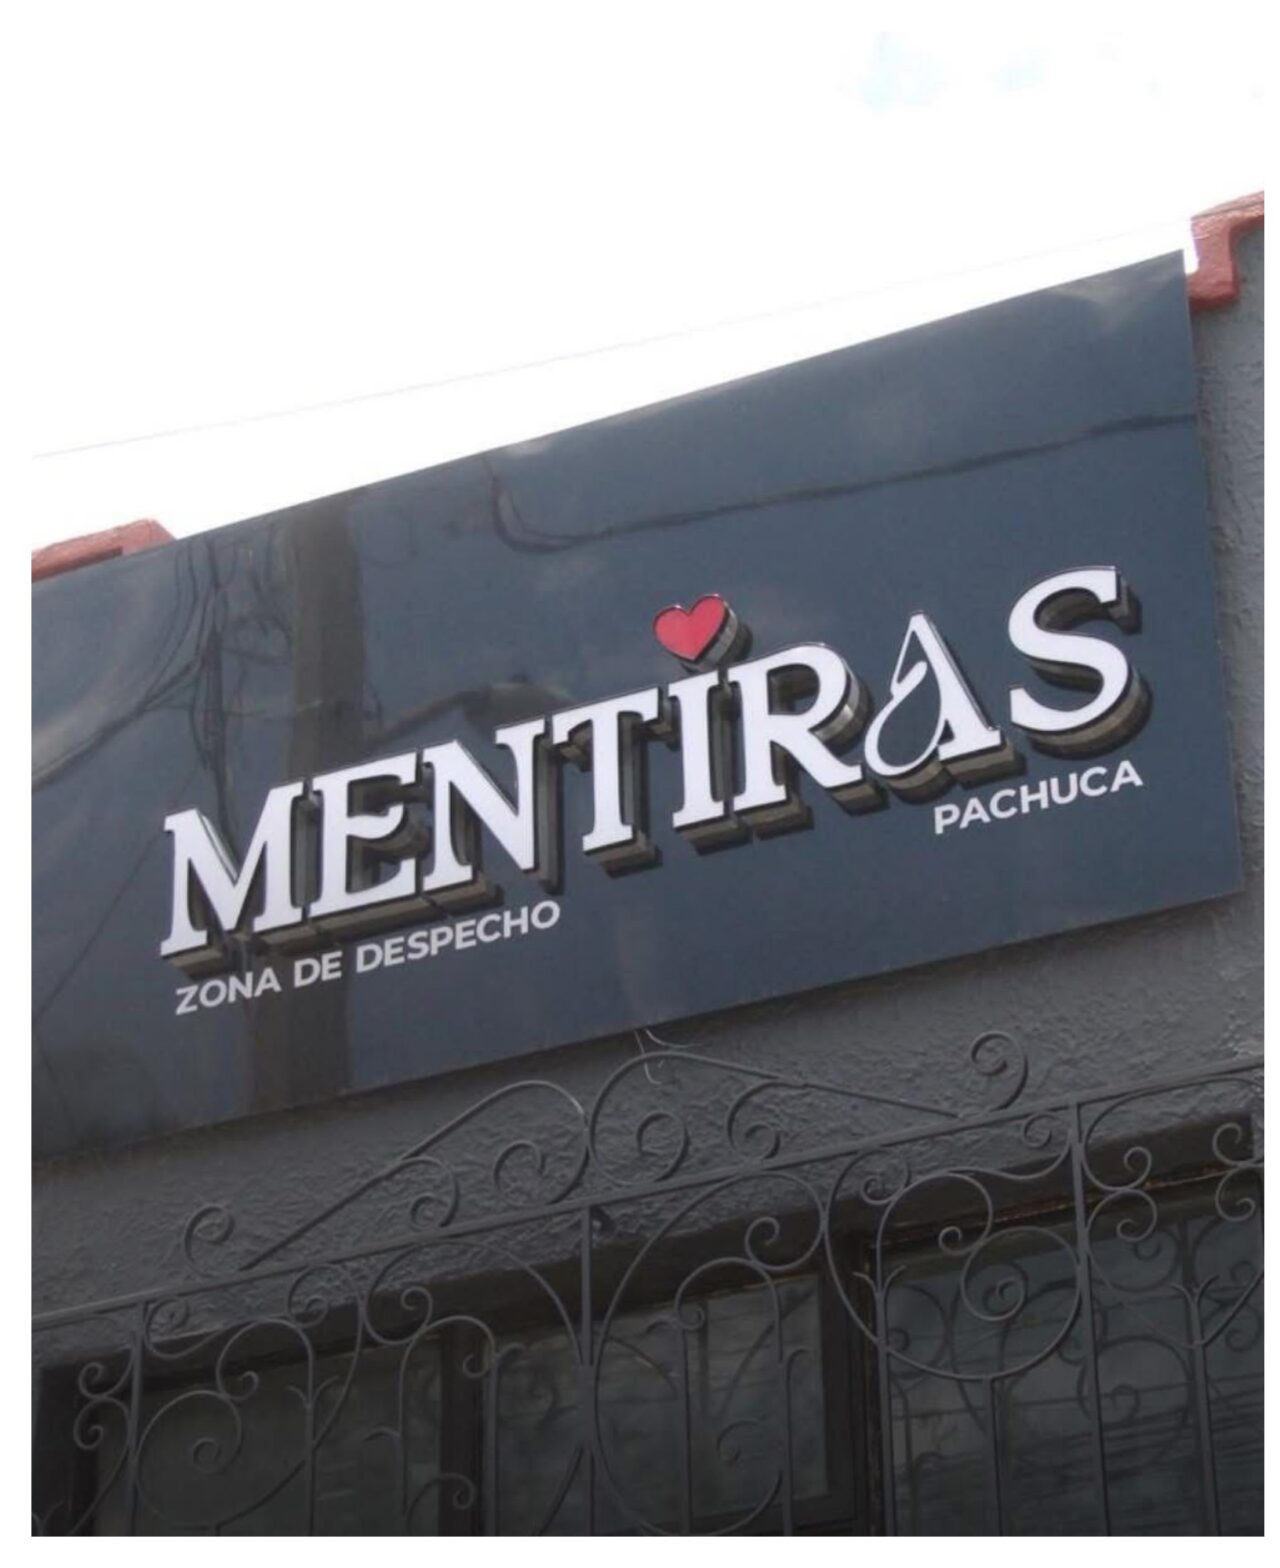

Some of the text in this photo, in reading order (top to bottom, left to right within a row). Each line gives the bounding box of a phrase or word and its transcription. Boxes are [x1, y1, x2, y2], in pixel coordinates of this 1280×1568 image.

[159, 565, 1134, 956] MENTIRAS
[934, 759, 1144, 835] PACHUCA
[176, 899, 561, 1015] ZONA DE DESPECHO
